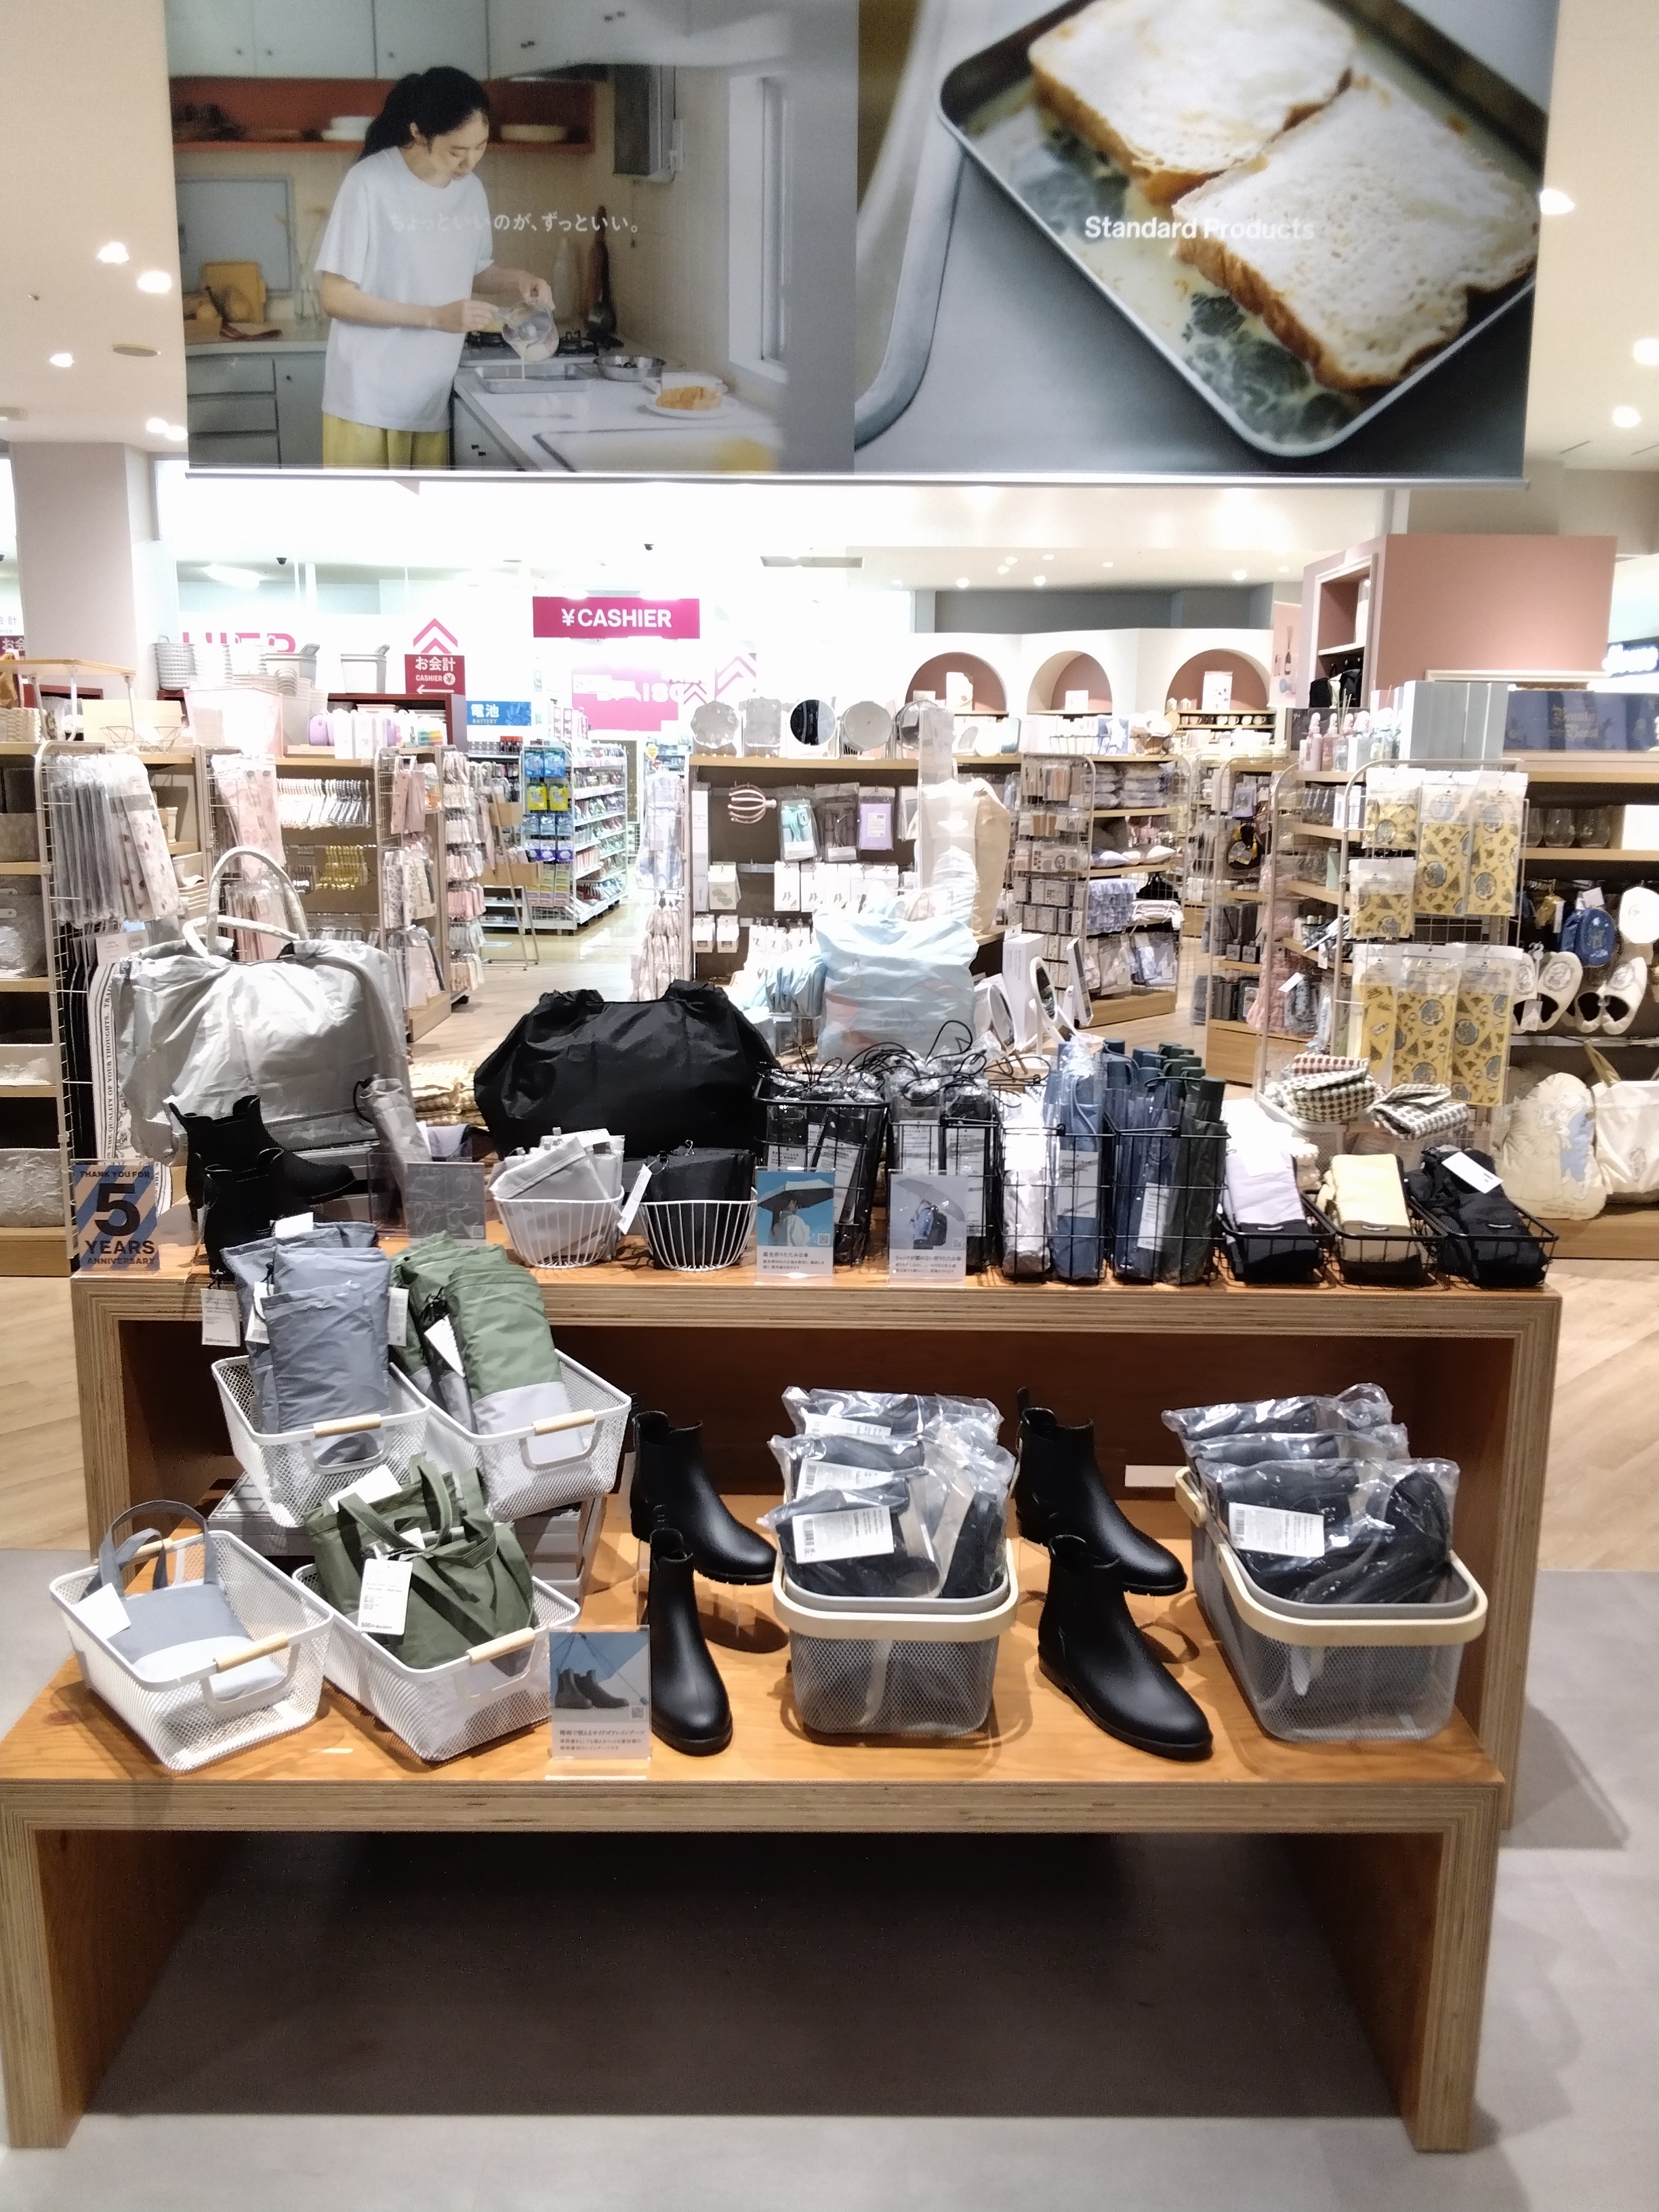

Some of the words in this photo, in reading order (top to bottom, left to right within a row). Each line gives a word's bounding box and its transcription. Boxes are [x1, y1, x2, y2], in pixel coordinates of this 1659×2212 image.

[1085, 216, 1197, 239] Standard
[1204, 217, 1315, 240] Products
[415, 656, 456, 672] お会計
[415, 674, 443, 682] CASHIER
[470, 703, 499, 718] 電池
[94, 1183, 141, 1237] 5
[85, 1240, 155, 1254] YEARS
